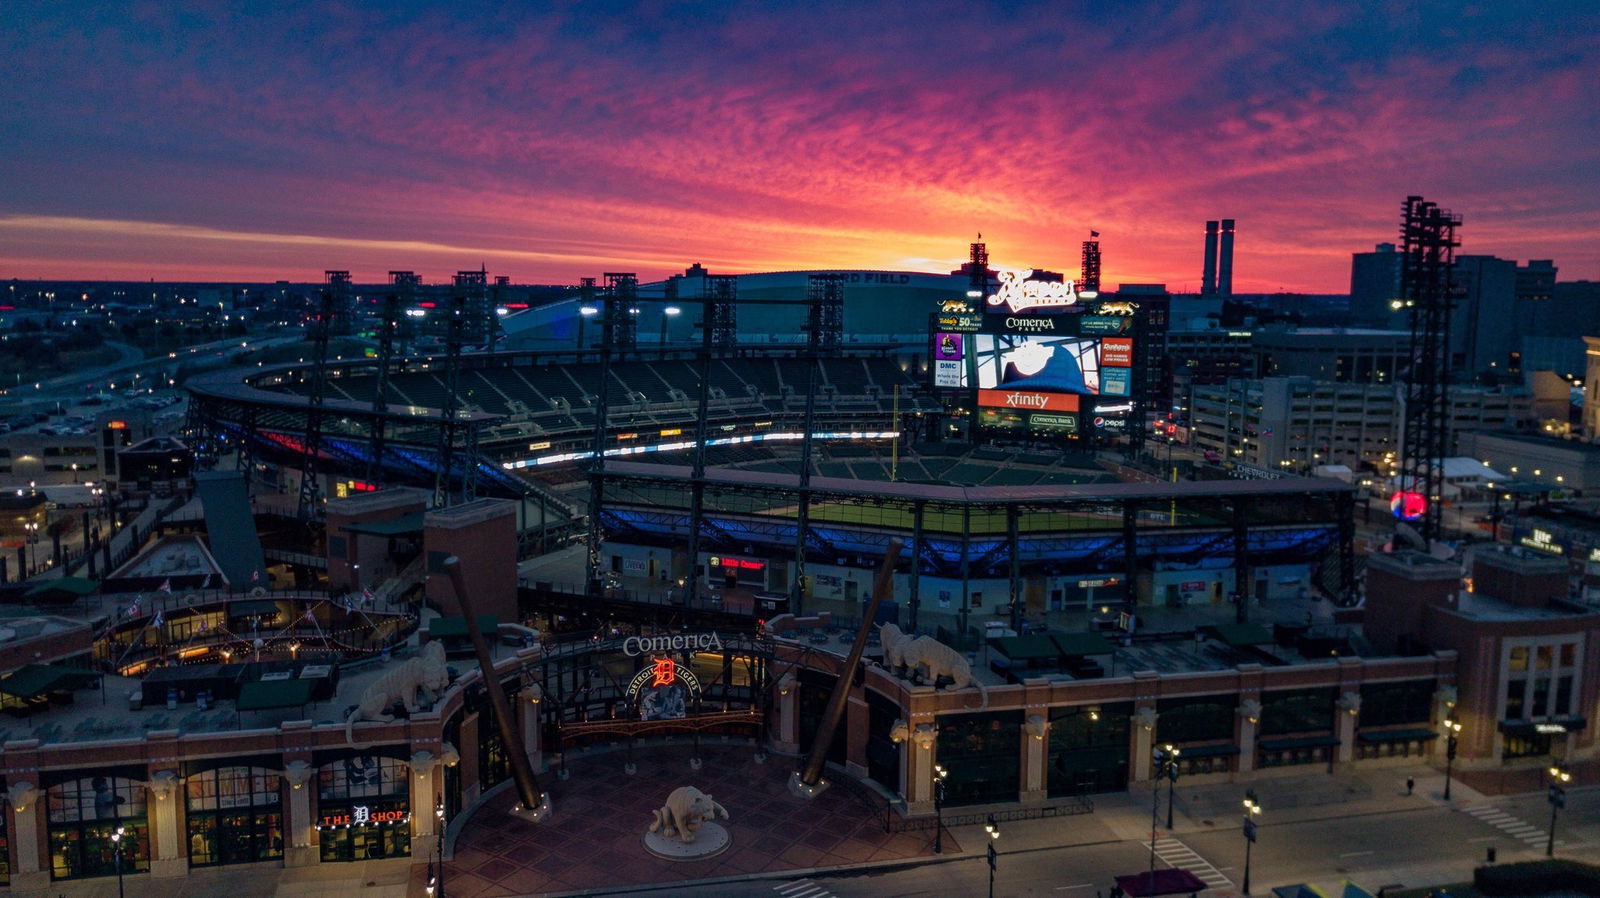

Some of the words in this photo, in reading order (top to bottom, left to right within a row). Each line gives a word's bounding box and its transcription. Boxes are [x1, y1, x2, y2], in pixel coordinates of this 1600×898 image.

[864, 273, 910, 284] FIELD
[959, 317, 970, 327] 50
[1006, 392, 1049, 409] xfinity
[1104, 419, 1125, 428] pepsi
[1237, 464, 1281, 480] CHEVROLET
[650, 651, 696, 661] PARK
[629, 667, 655, 694] DETROIT
[676, 667, 699, 691] TIGERS
[323, 815, 351, 825] THE
[370, 810, 404, 822] SHOP
